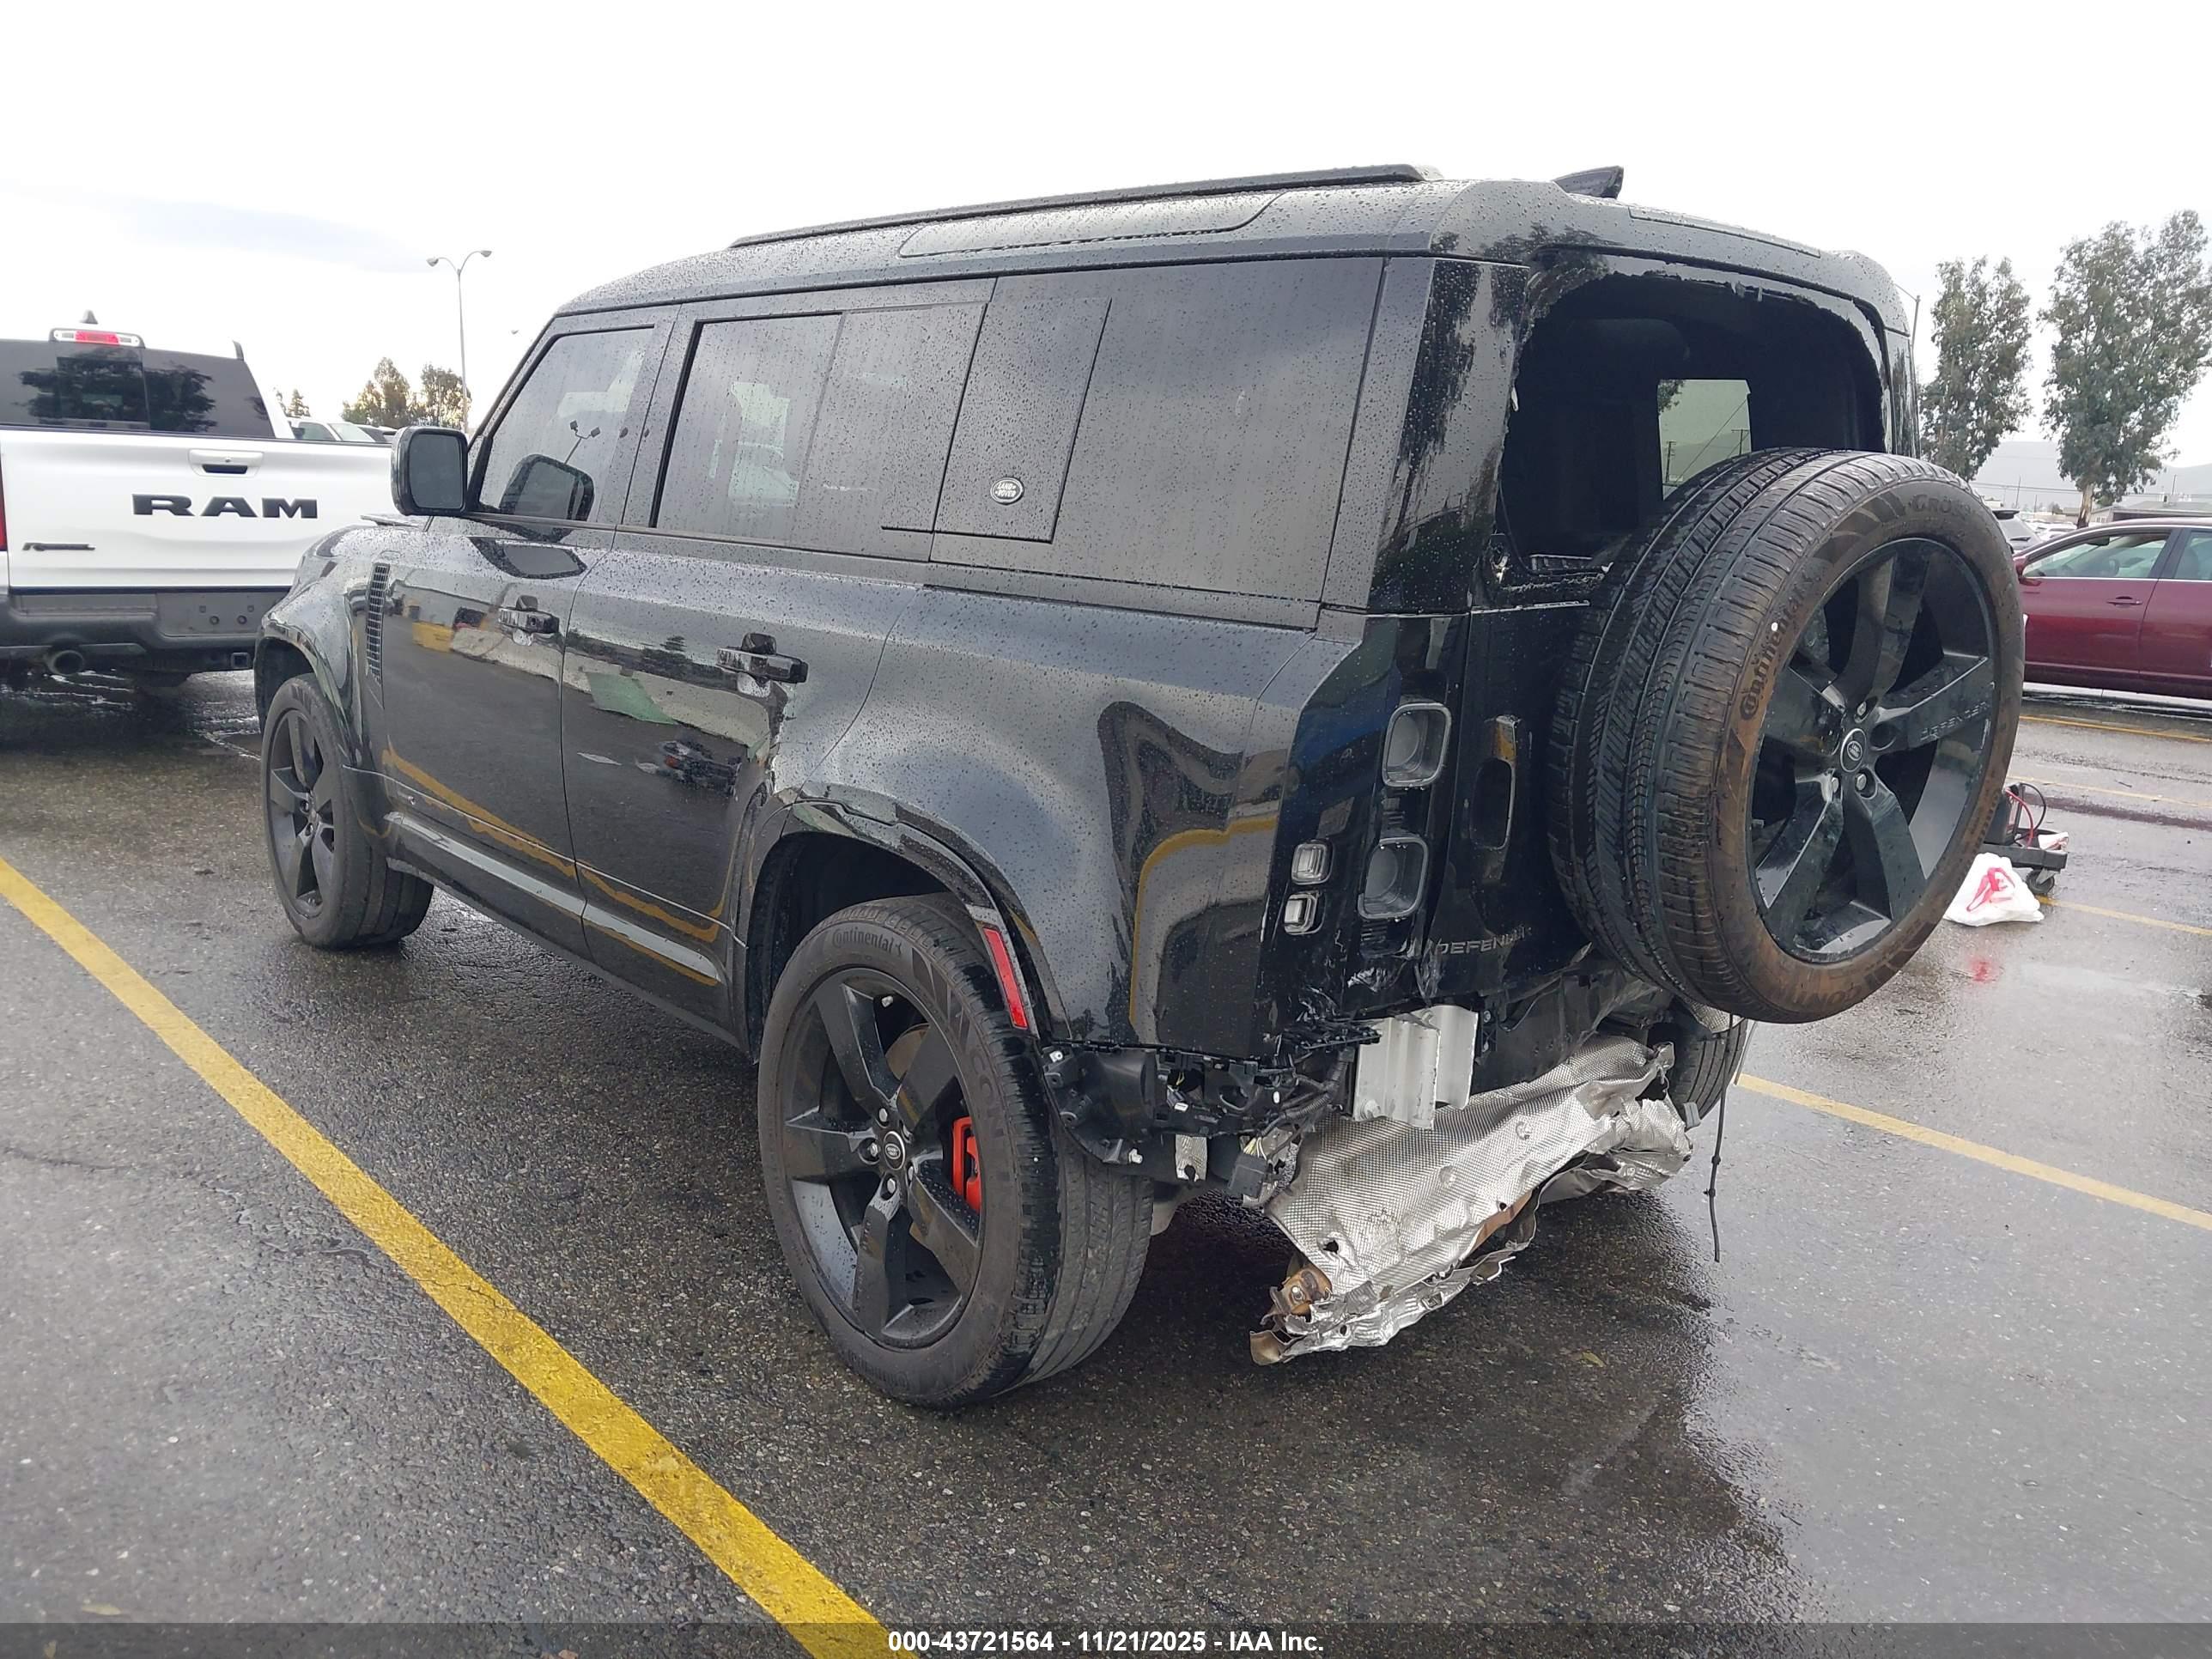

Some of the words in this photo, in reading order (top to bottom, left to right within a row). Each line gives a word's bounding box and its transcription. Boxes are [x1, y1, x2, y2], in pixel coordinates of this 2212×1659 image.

[131, 494, 318, 519] RAM
[1919, 701, 1990, 741] DEFENDER
[832, 926, 894, 955] Continental
